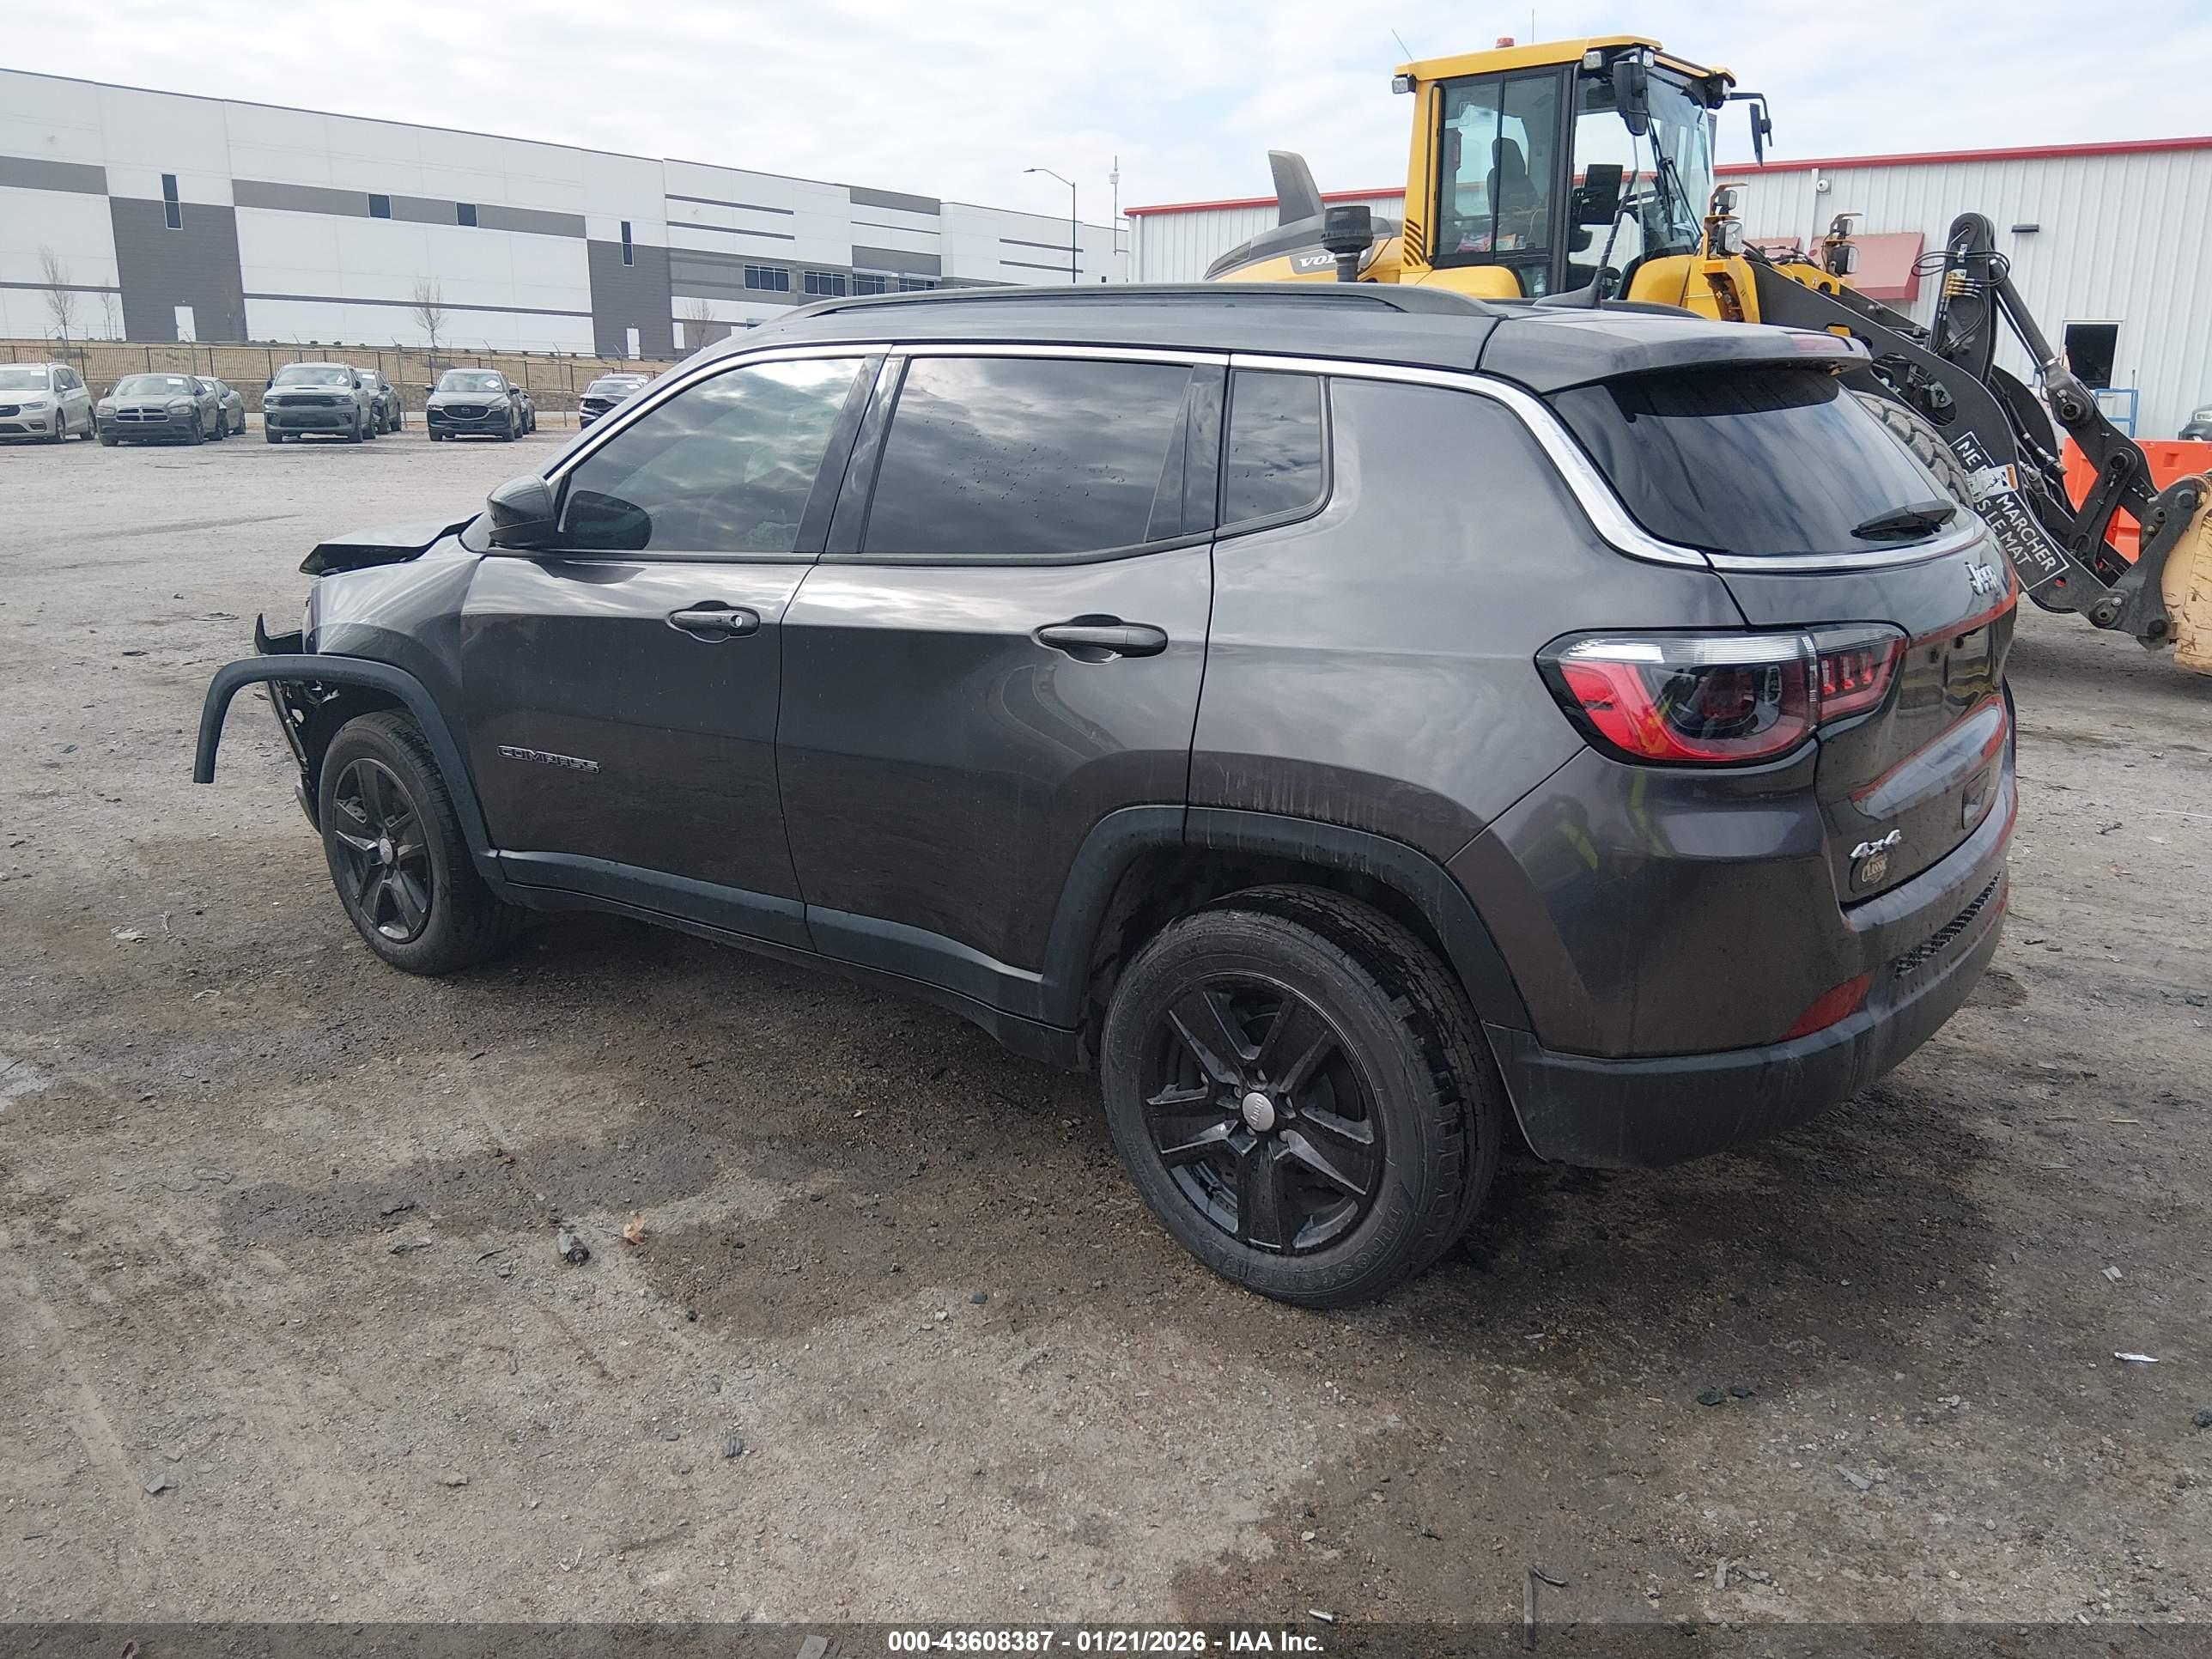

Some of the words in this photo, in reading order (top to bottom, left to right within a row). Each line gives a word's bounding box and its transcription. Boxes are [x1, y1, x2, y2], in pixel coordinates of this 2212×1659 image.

[1957, 441, 1982, 466] NE
[1996, 494, 2057, 572] MARCHER
[1984, 512, 2007, 533] LE
[2000, 529, 2033, 566] MAT
[497, 745, 600, 774] COMPASS
